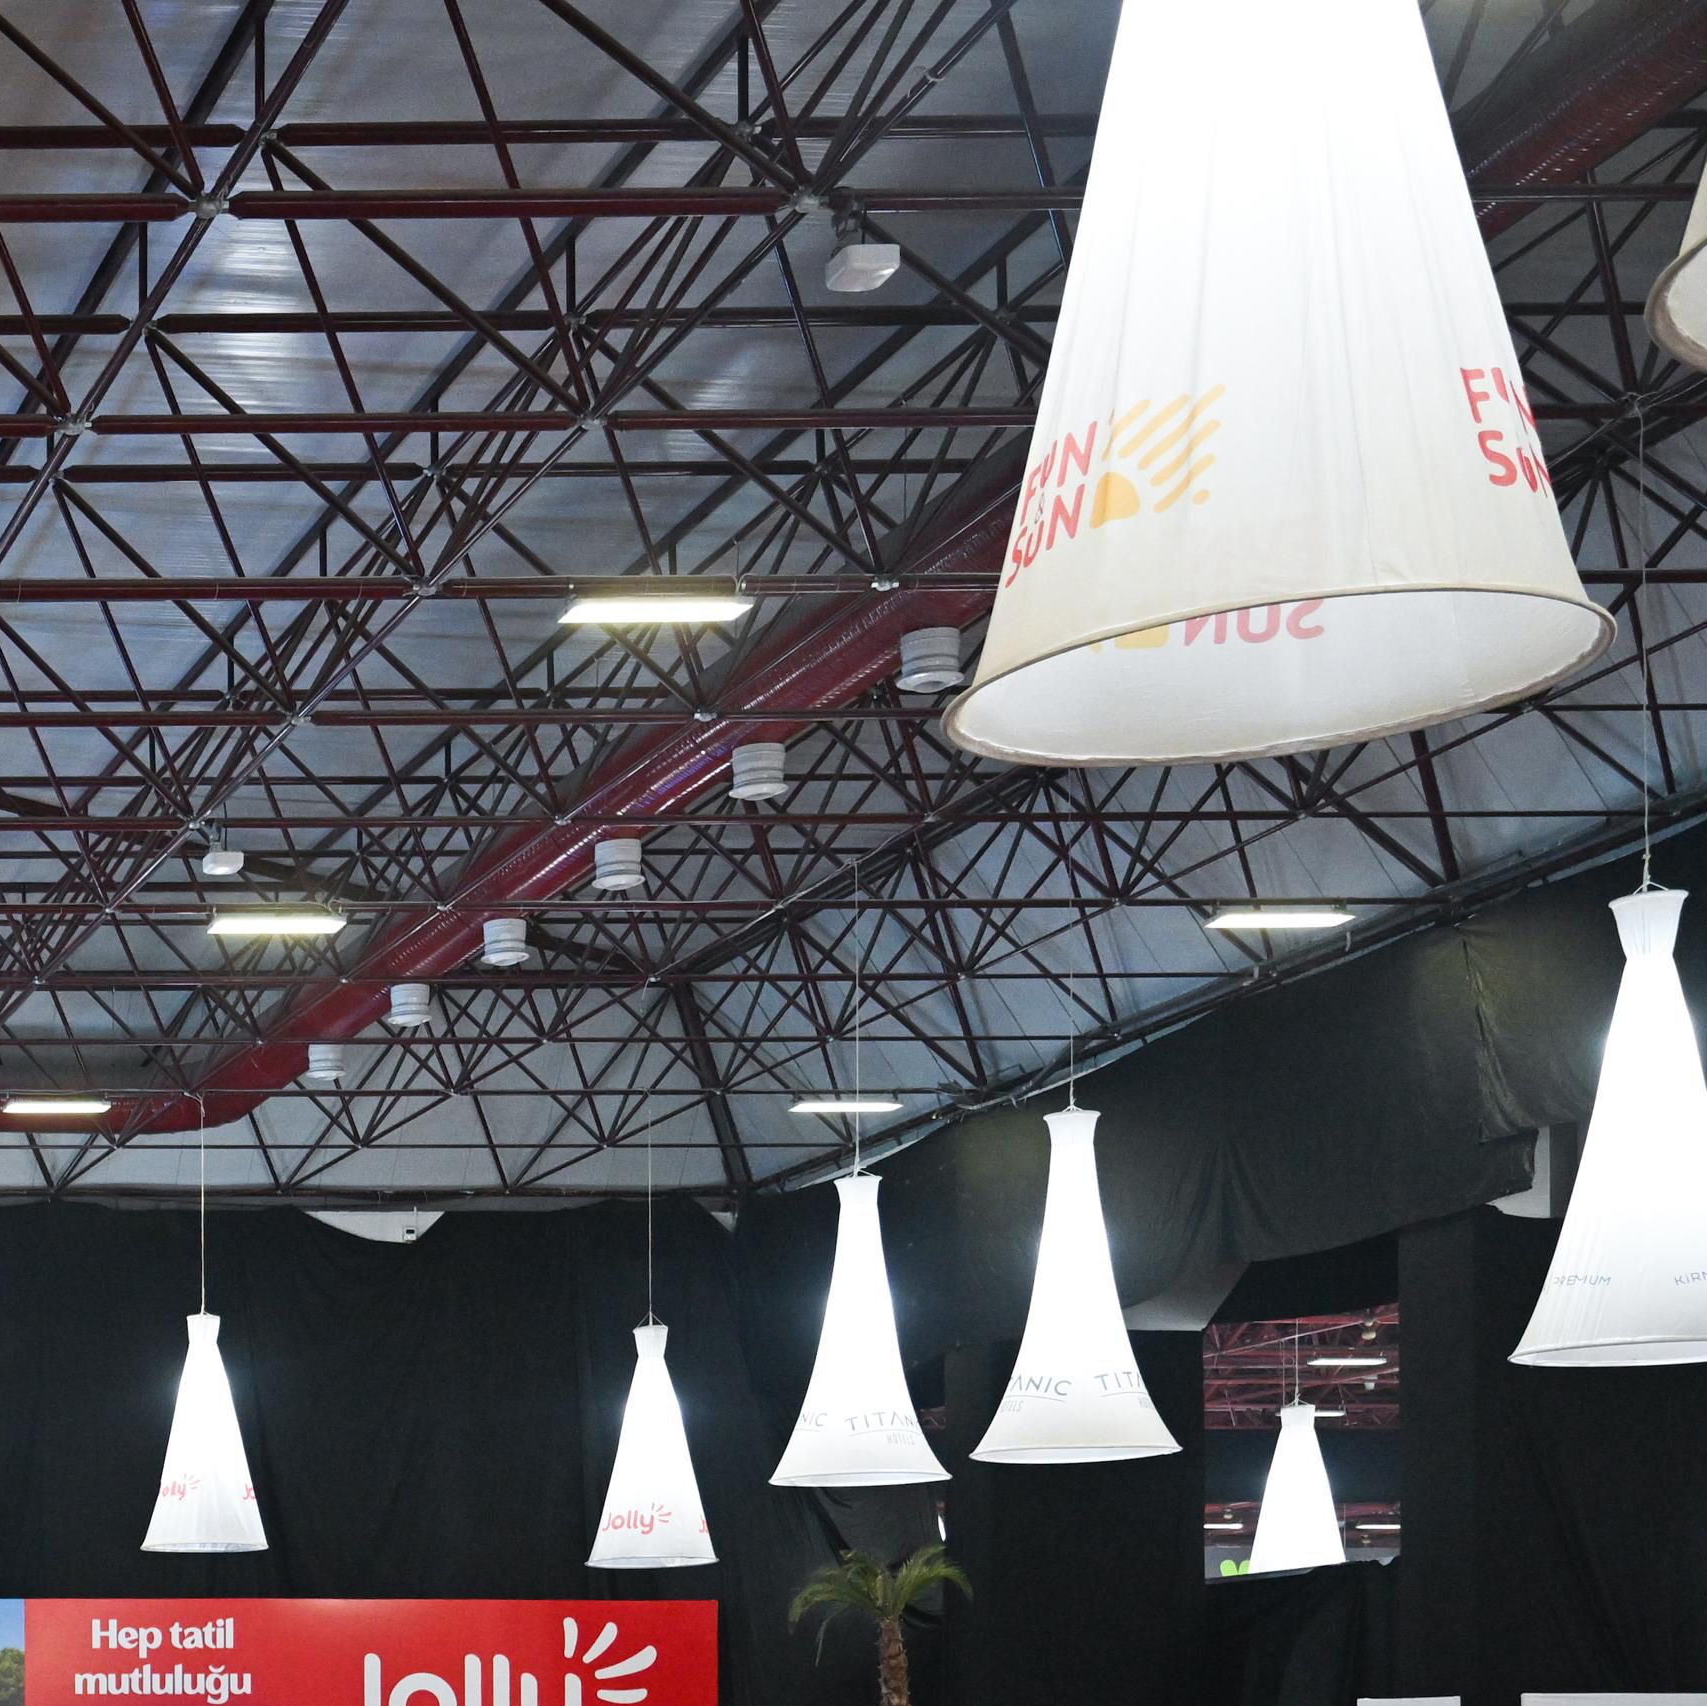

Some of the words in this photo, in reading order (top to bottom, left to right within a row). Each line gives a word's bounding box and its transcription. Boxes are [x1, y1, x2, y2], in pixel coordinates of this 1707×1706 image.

[602, 1509, 655, 1535] Jolly
[90, 1617, 163, 1659] Hep
[170, 1616, 235, 1651] tatil
[74, 1663, 252, 1705] mutluluğu
